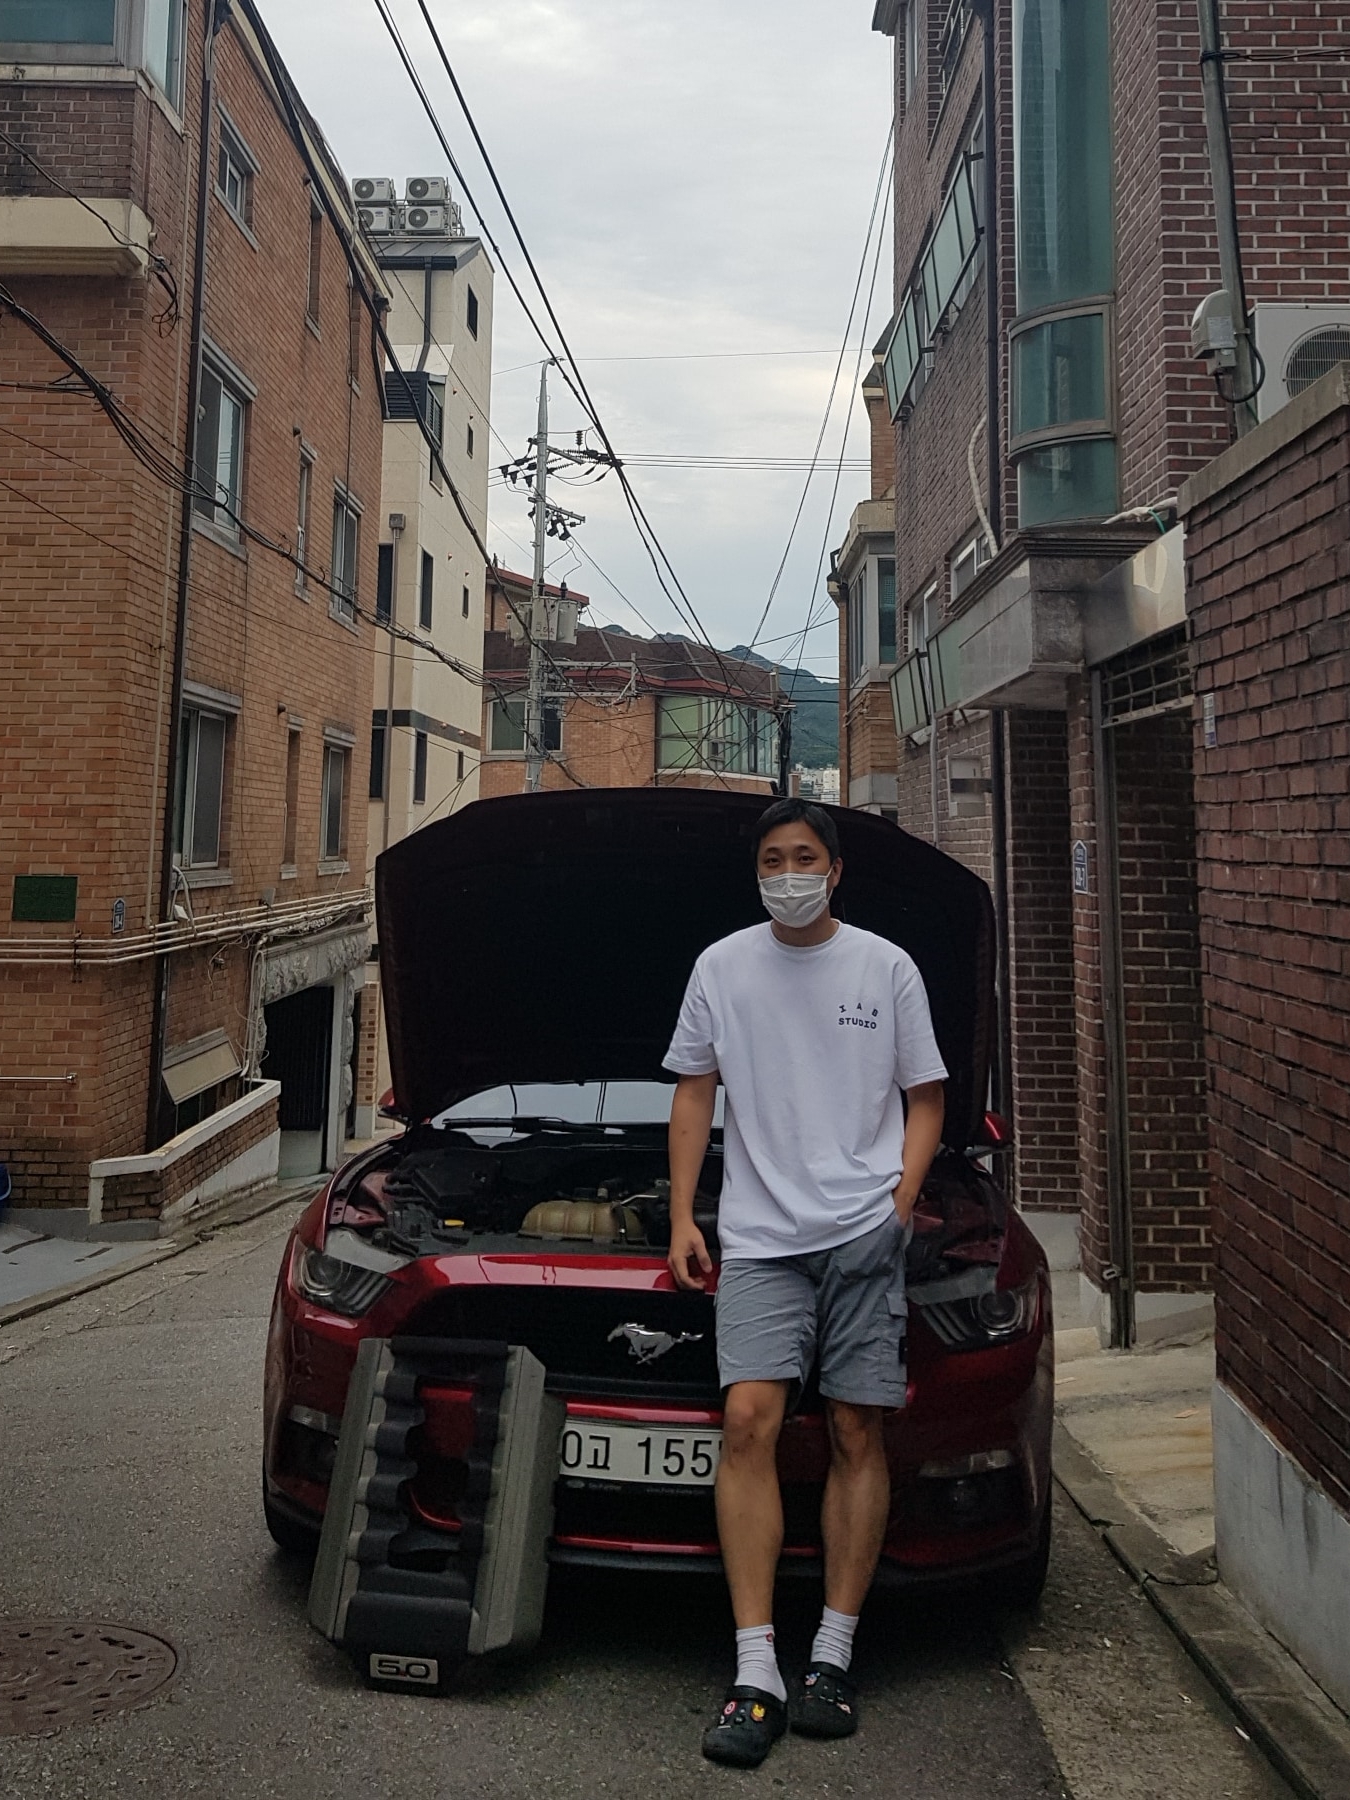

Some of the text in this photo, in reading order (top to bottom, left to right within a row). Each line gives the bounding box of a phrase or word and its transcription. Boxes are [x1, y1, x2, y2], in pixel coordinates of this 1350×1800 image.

[838, 1017, 877, 1030] STUDIO
[637, 1437, 722, 1478] 155
[378, 1660, 430, 1679] 5.0
